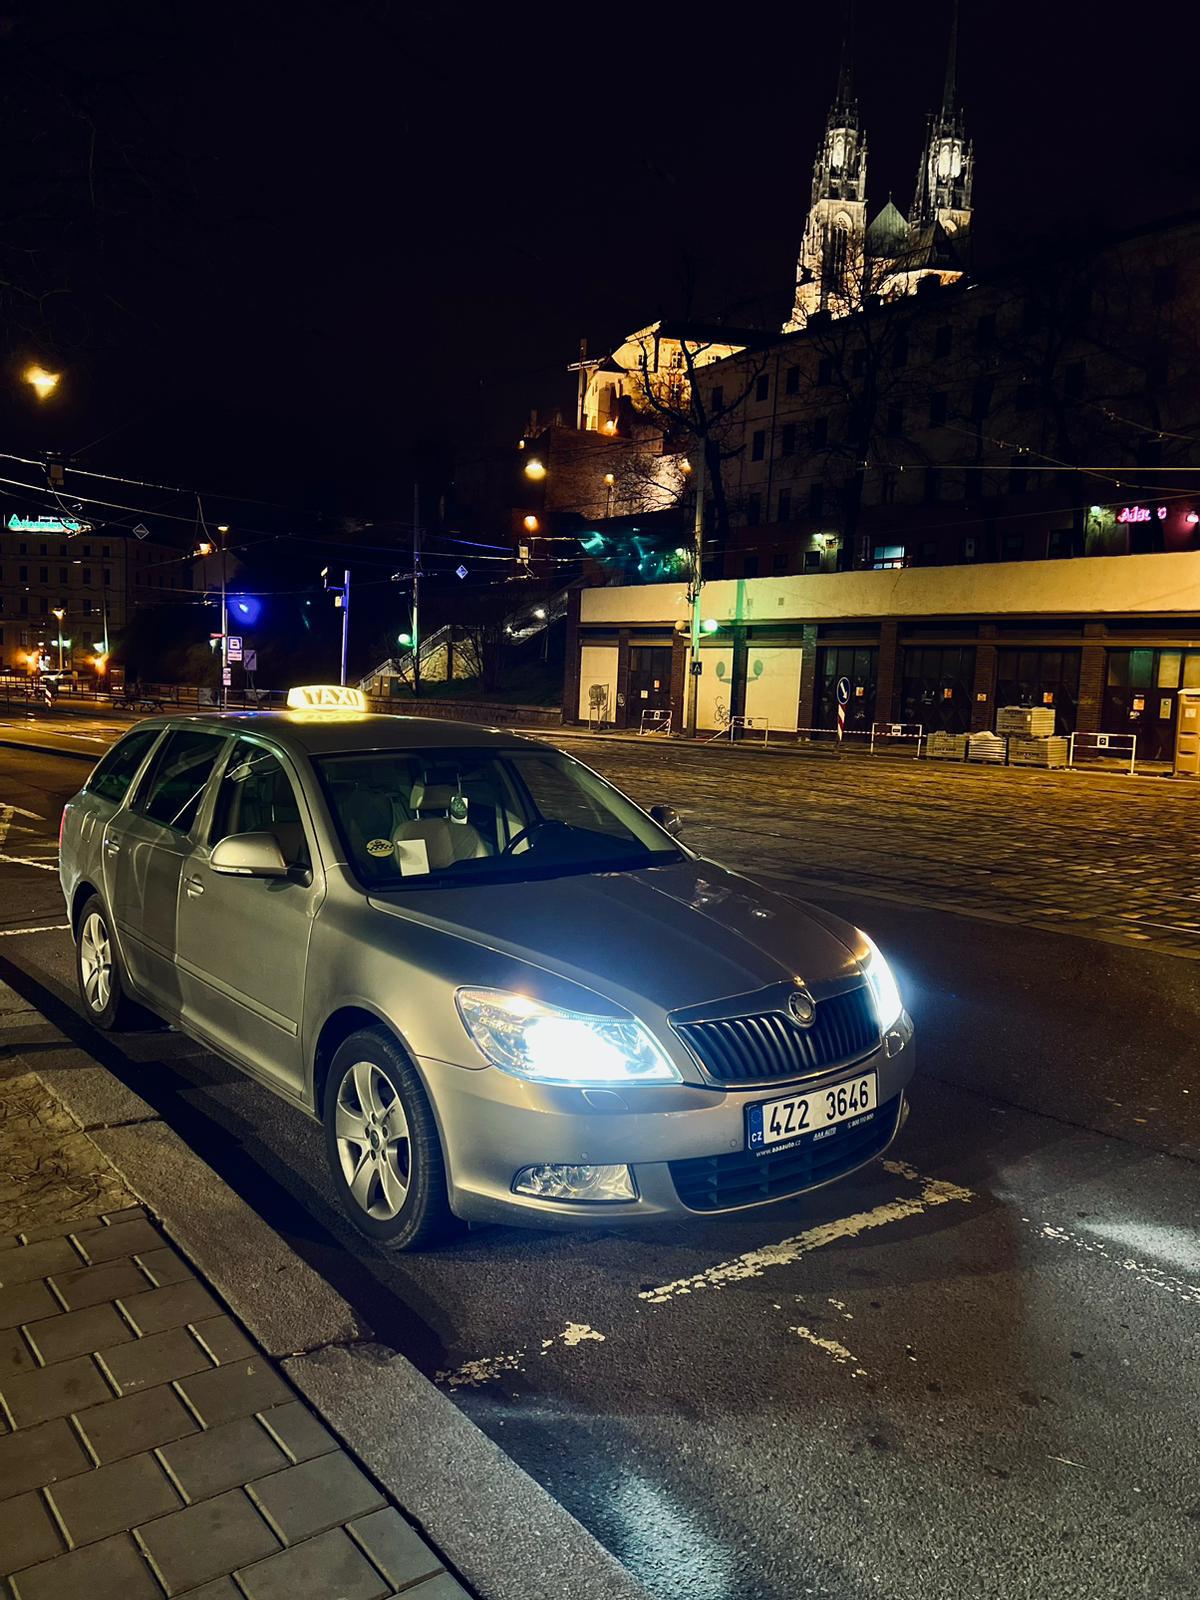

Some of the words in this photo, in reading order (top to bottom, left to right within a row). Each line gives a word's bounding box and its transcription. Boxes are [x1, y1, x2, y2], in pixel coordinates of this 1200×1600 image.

[301, 688, 361, 705] TAXI
[769, 1100, 810, 1136] 4Z2
[825, 1080, 869, 1120] 3646
[751, 1131, 763, 1143] CZ
